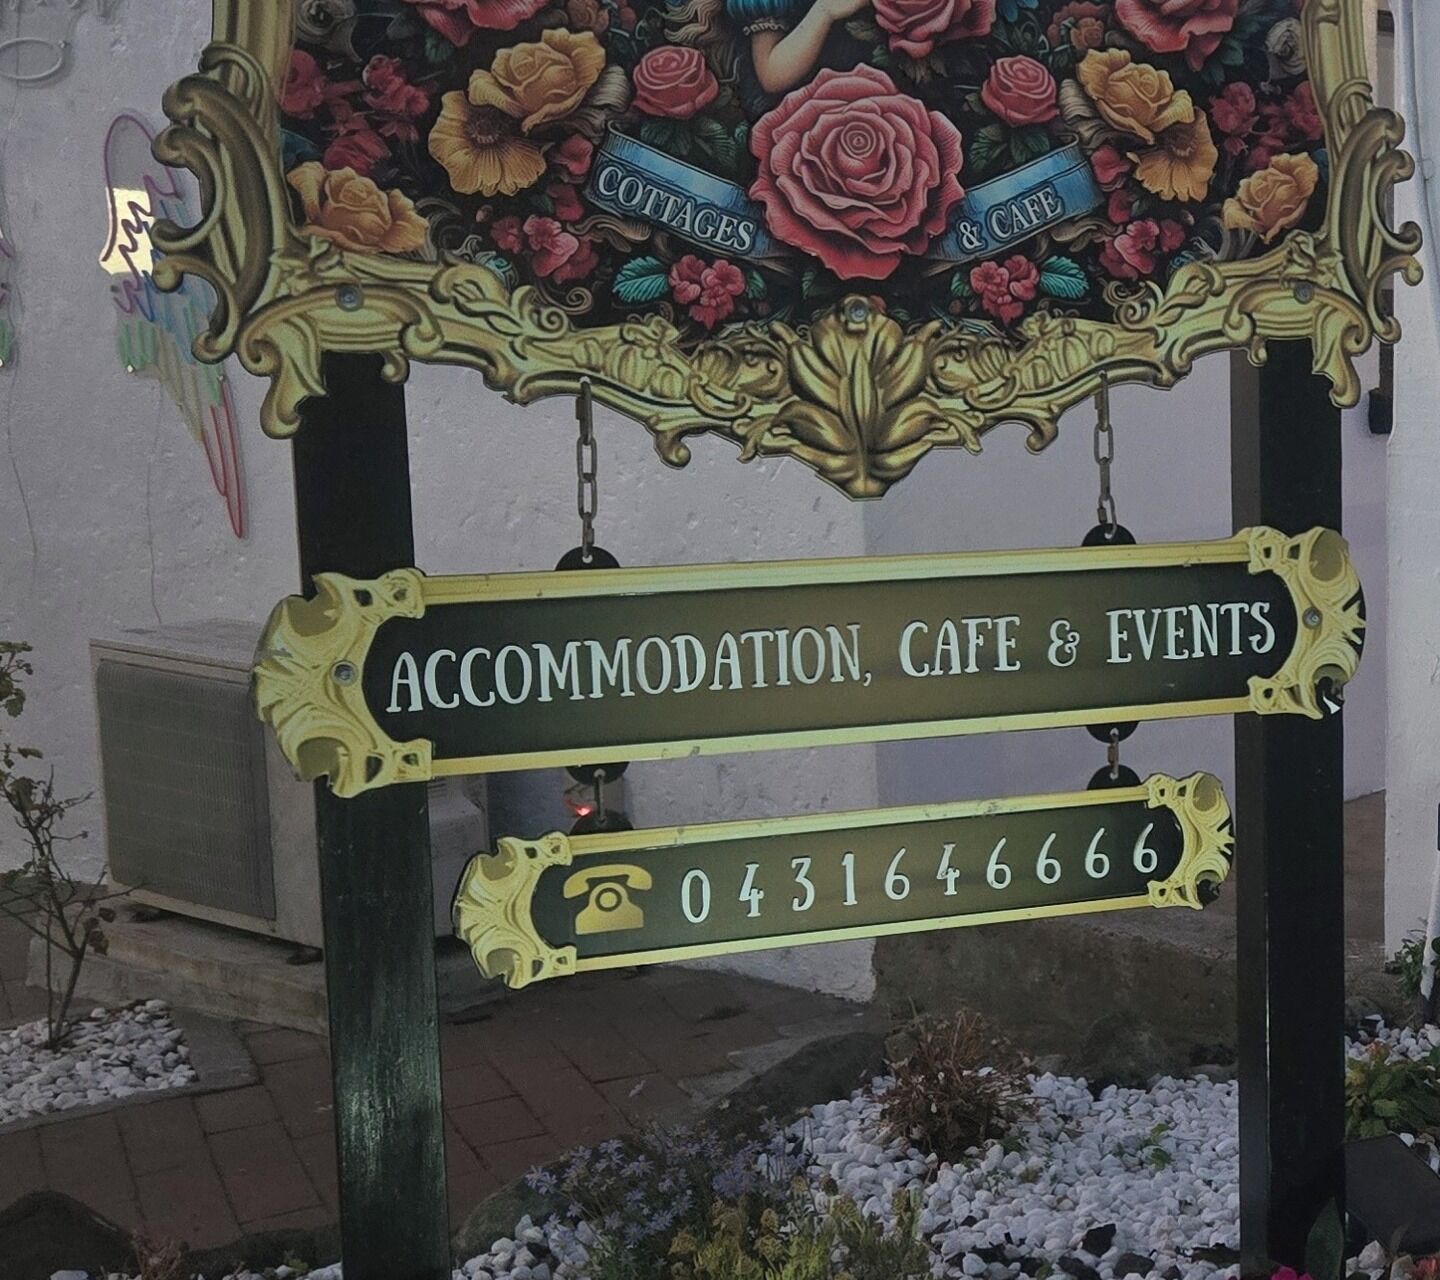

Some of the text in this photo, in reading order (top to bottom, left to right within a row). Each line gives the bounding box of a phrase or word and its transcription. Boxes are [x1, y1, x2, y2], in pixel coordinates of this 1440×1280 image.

[597, 165, 1063, 251] COTTAGES & CAFE
[385, 602, 1276, 713] ACCOMMODATION, CAFE & EVENTS
